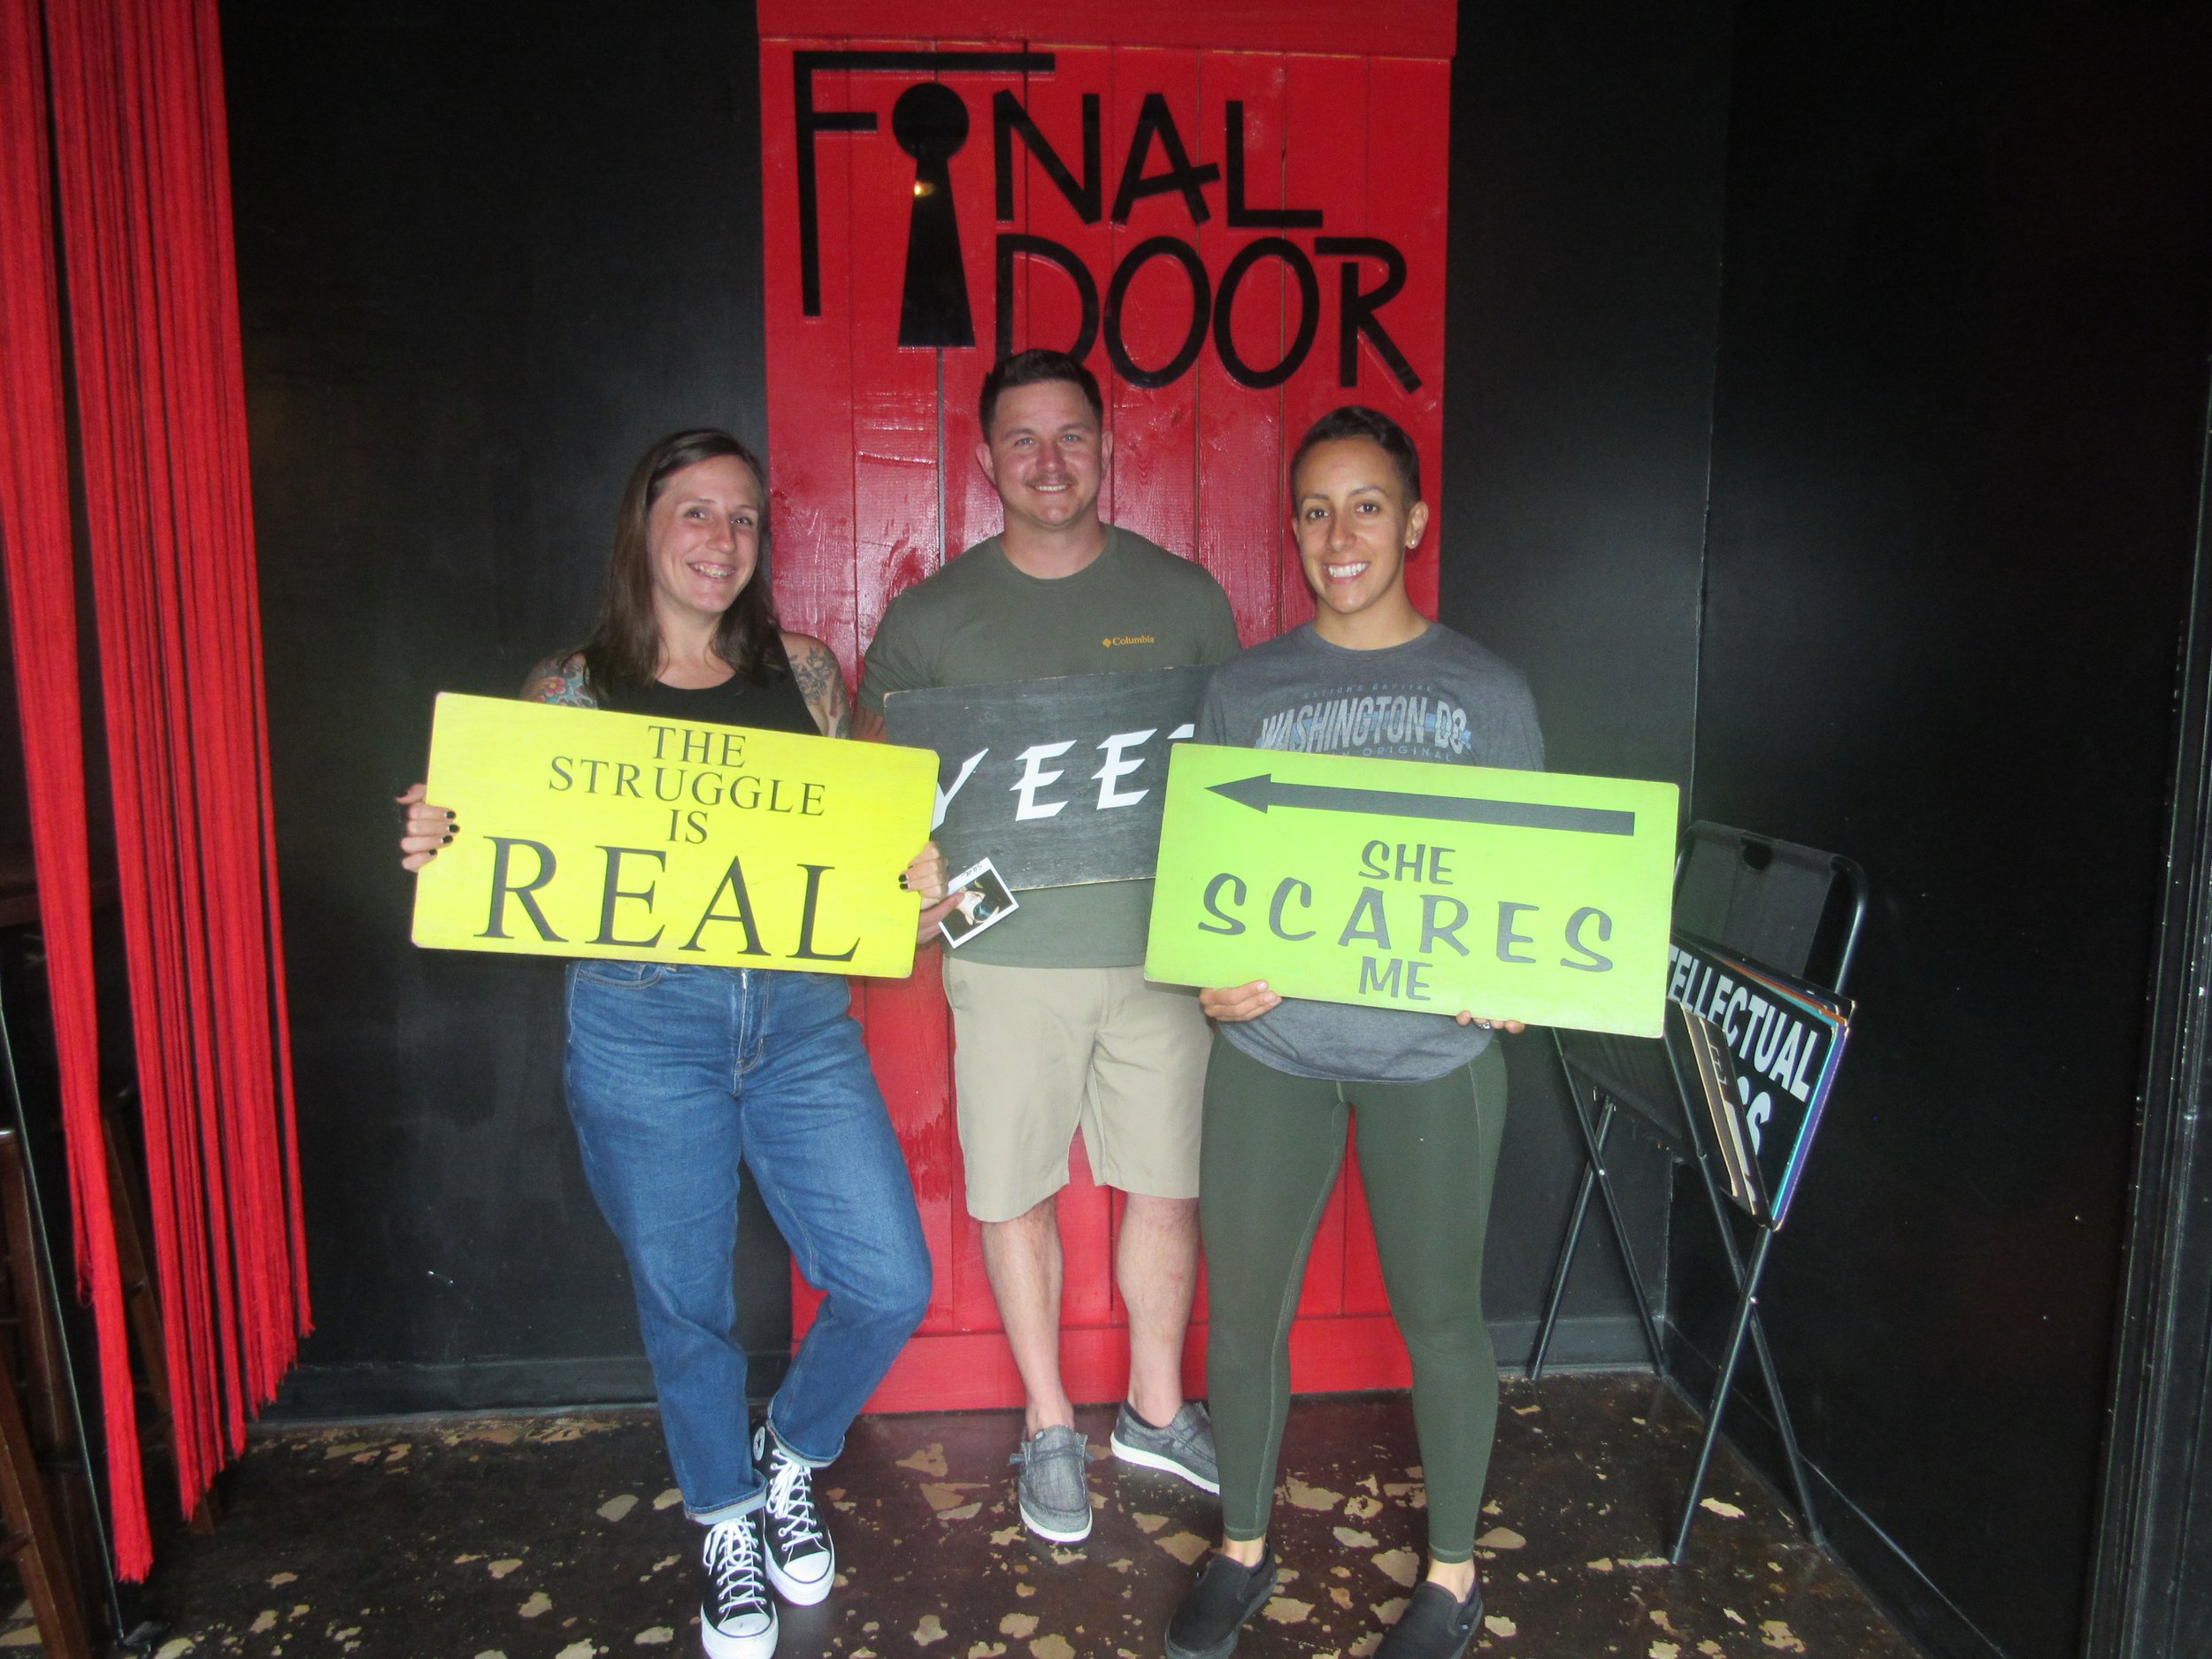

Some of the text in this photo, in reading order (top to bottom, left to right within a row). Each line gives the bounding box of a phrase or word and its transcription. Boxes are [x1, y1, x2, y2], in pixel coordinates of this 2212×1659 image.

[996, 234, 1422, 394] DOOR
[1112, 635, 1155, 646] Columbia
[648, 726, 747, 768] THE
[1260, 695, 1428, 753] WASHINGTON
[931, 724, 1194, 832] YEE
[1363, 745, 1451, 762] ORIGINAL
[549, 756, 826, 817] STRUGGLE
[666, 809, 708, 844] IS
[1359, 840, 1455, 885] SHE
[473, 835, 861, 963] REAL
[1198, 872, 1613, 972] SCARES
[1359, 956, 1433, 1001] ME
